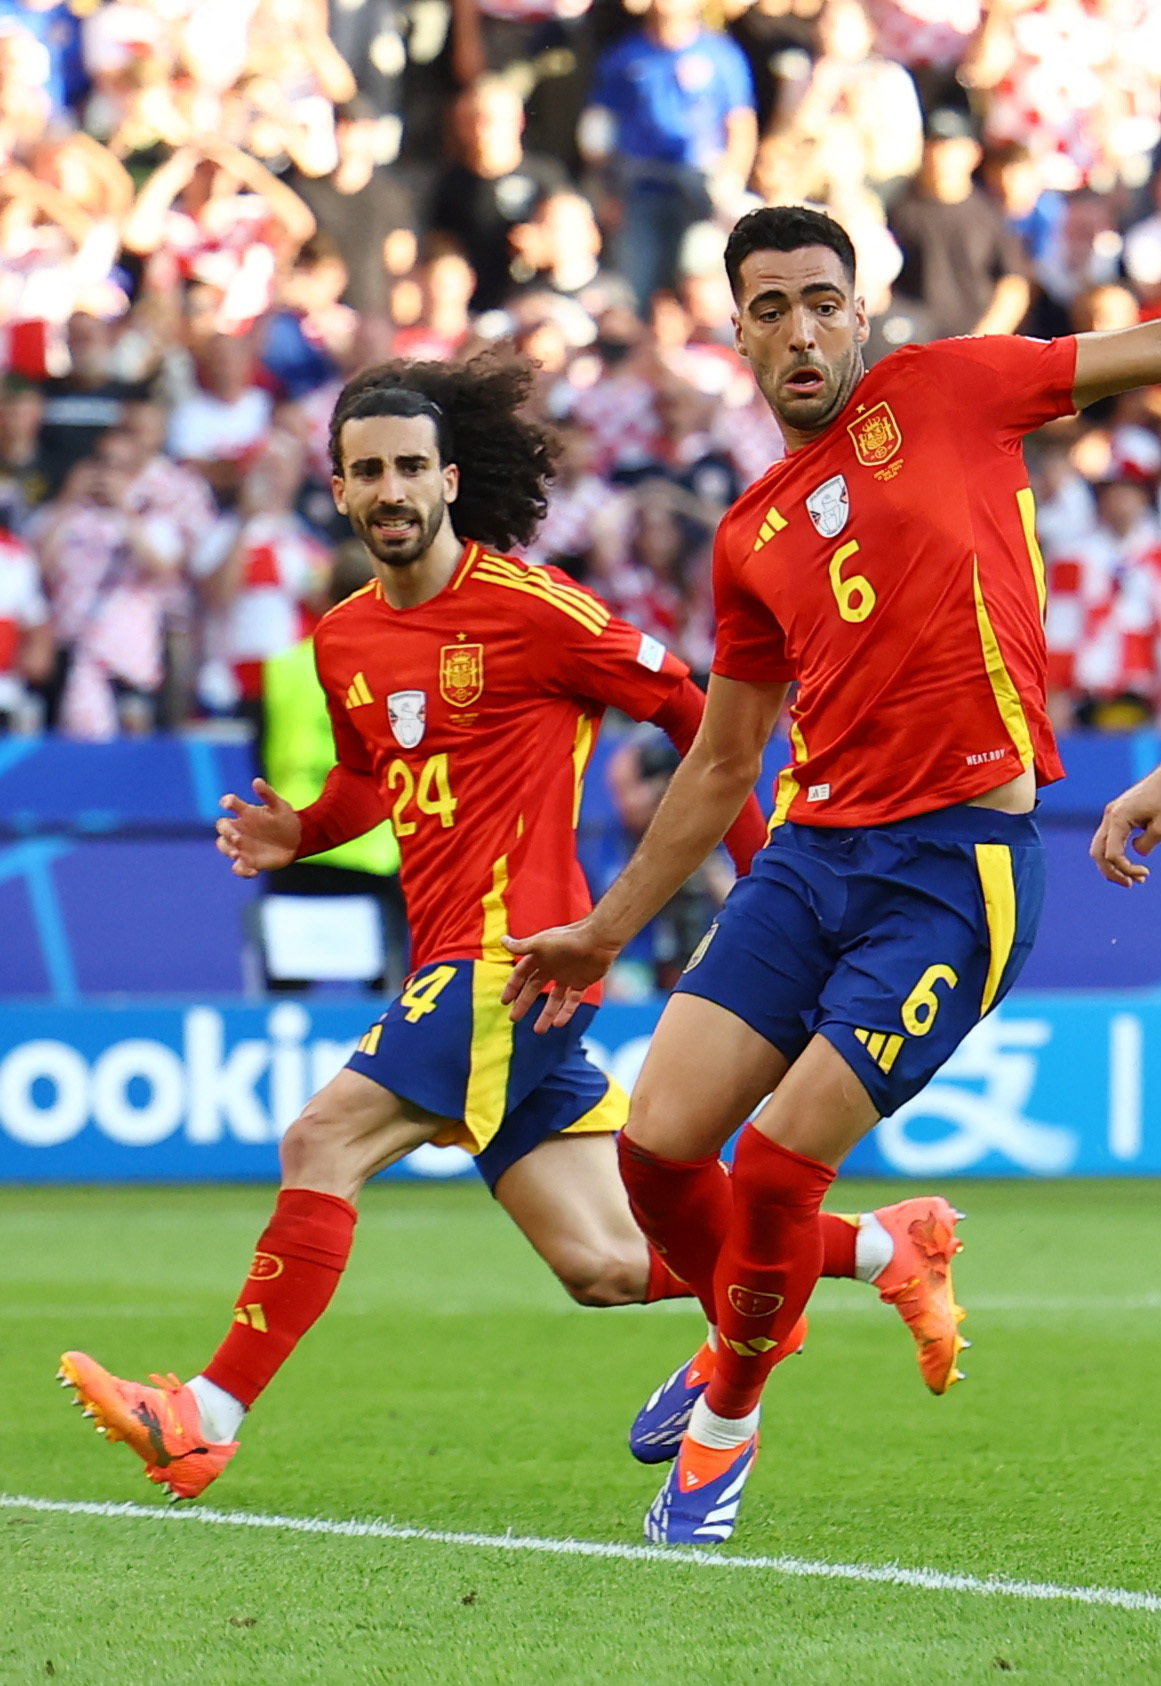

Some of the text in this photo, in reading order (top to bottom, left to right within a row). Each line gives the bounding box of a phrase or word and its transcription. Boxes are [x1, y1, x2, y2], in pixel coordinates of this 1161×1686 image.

[828, 539, 876, 623] 6
[386, 752, 458, 837] 24
[402, 964, 459, 1024] 4
[901, 963, 959, 1036] 6
